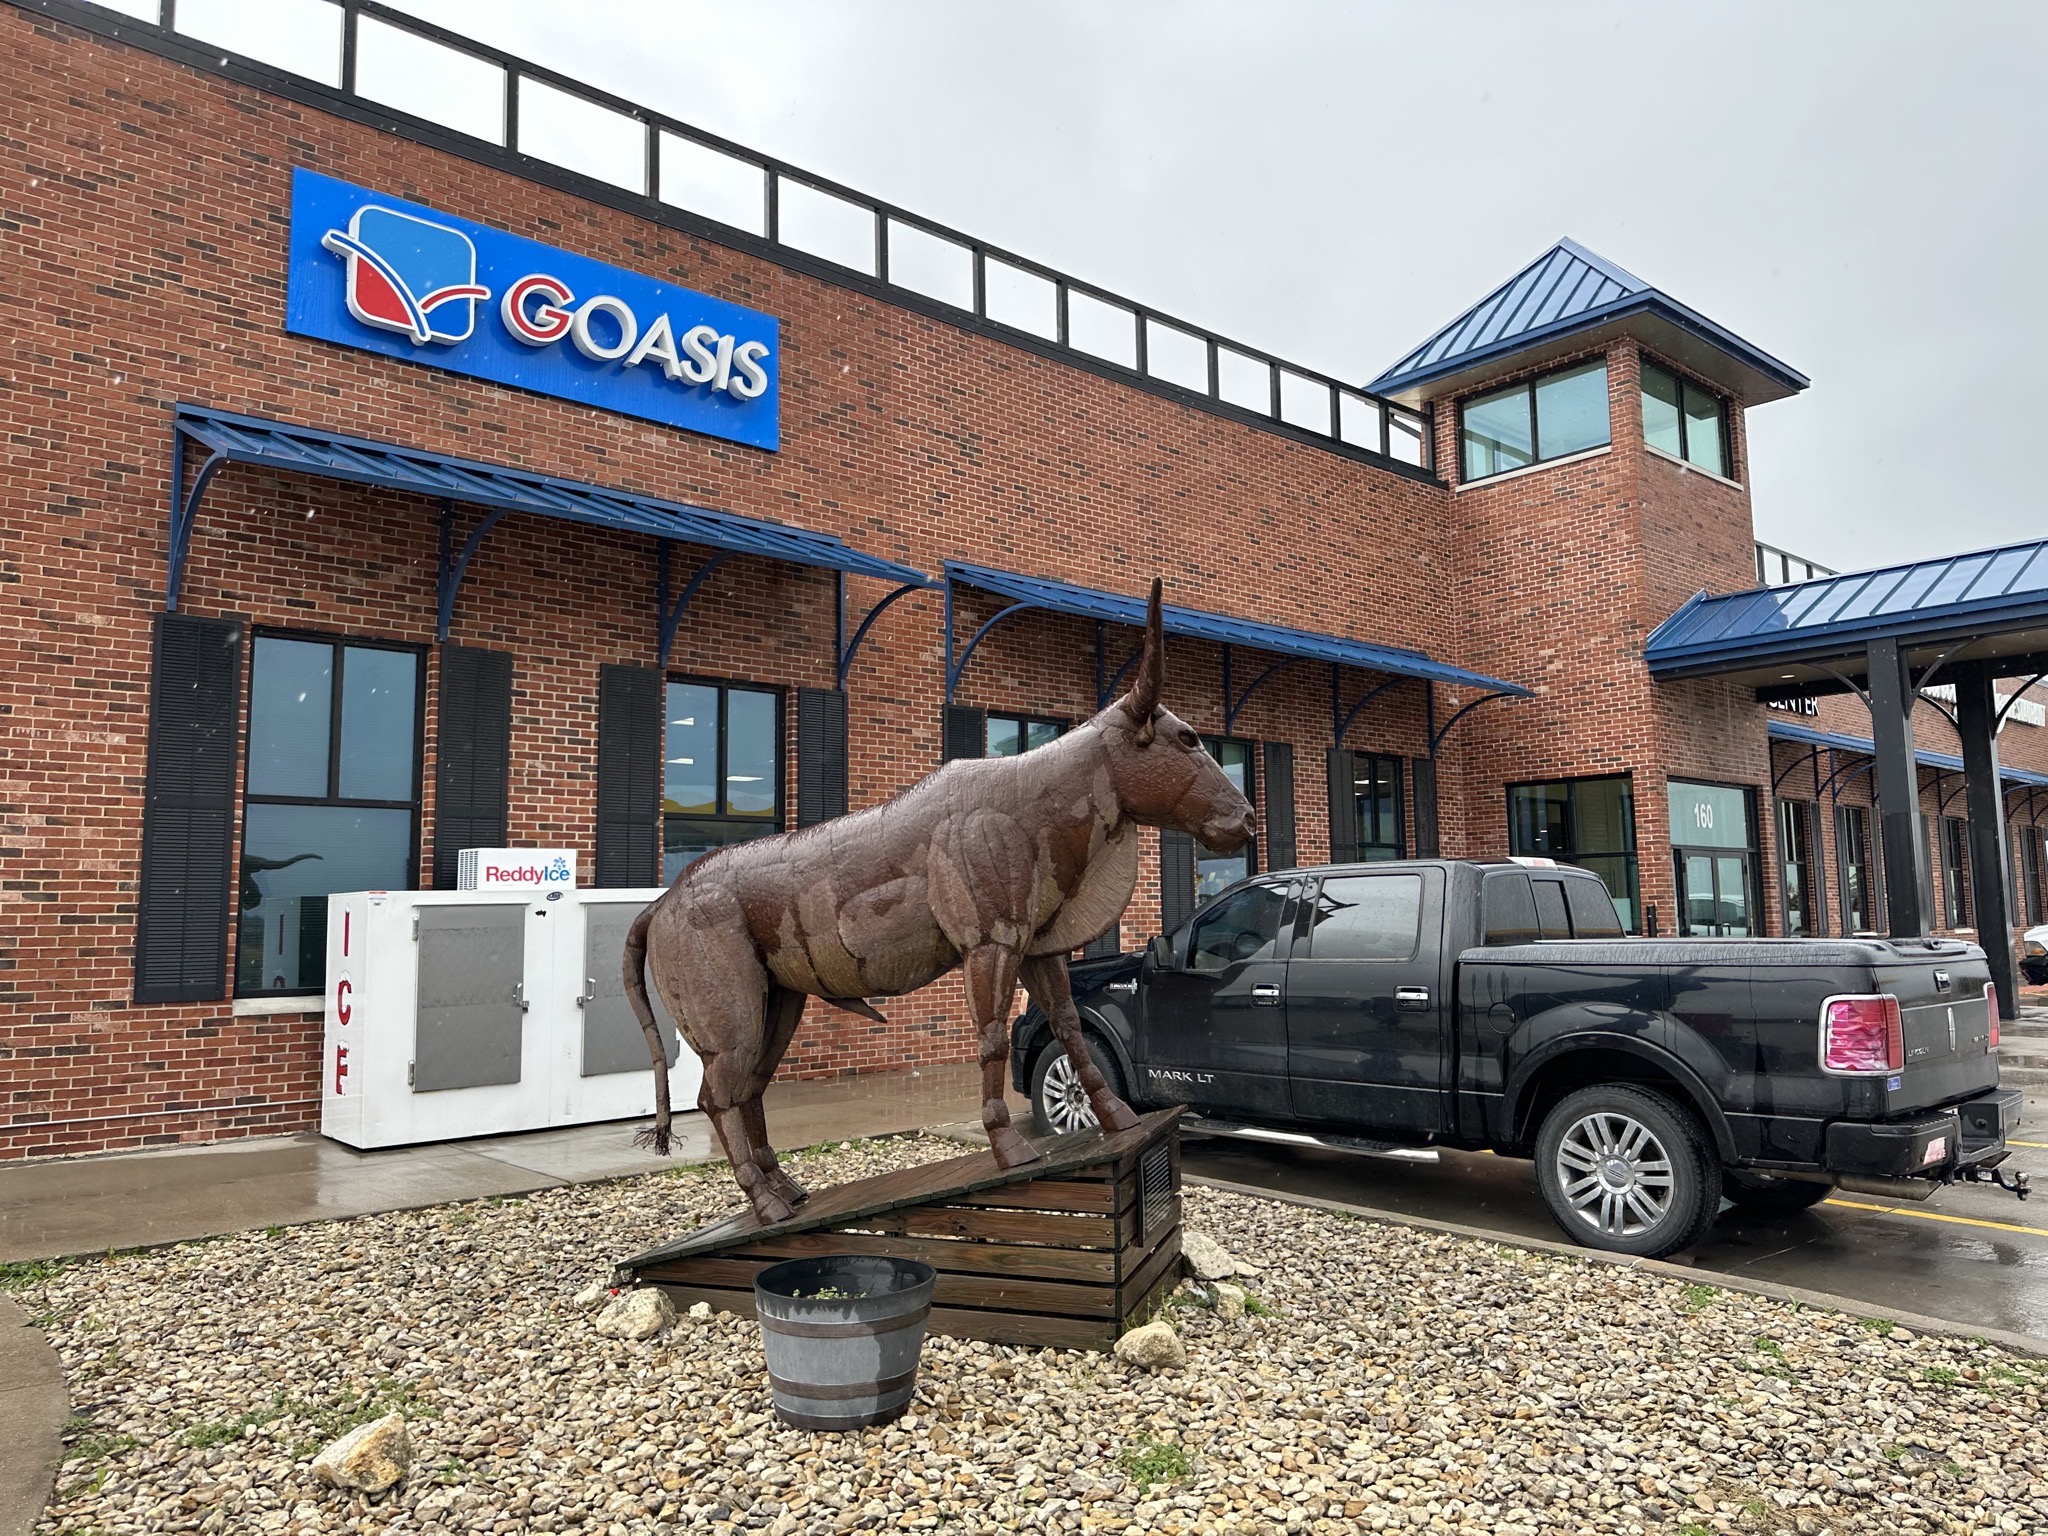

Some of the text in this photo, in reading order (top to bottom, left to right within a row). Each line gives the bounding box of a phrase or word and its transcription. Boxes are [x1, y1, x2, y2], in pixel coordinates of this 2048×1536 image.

[501, 274, 770, 400] GOASIS
[1768, 696, 1820, 717] NTER
[1694, 802, 1713, 829] 160
[485, 866, 570, 885] ReddyIce
[1148, 1069, 1215, 1084] MARK LT
